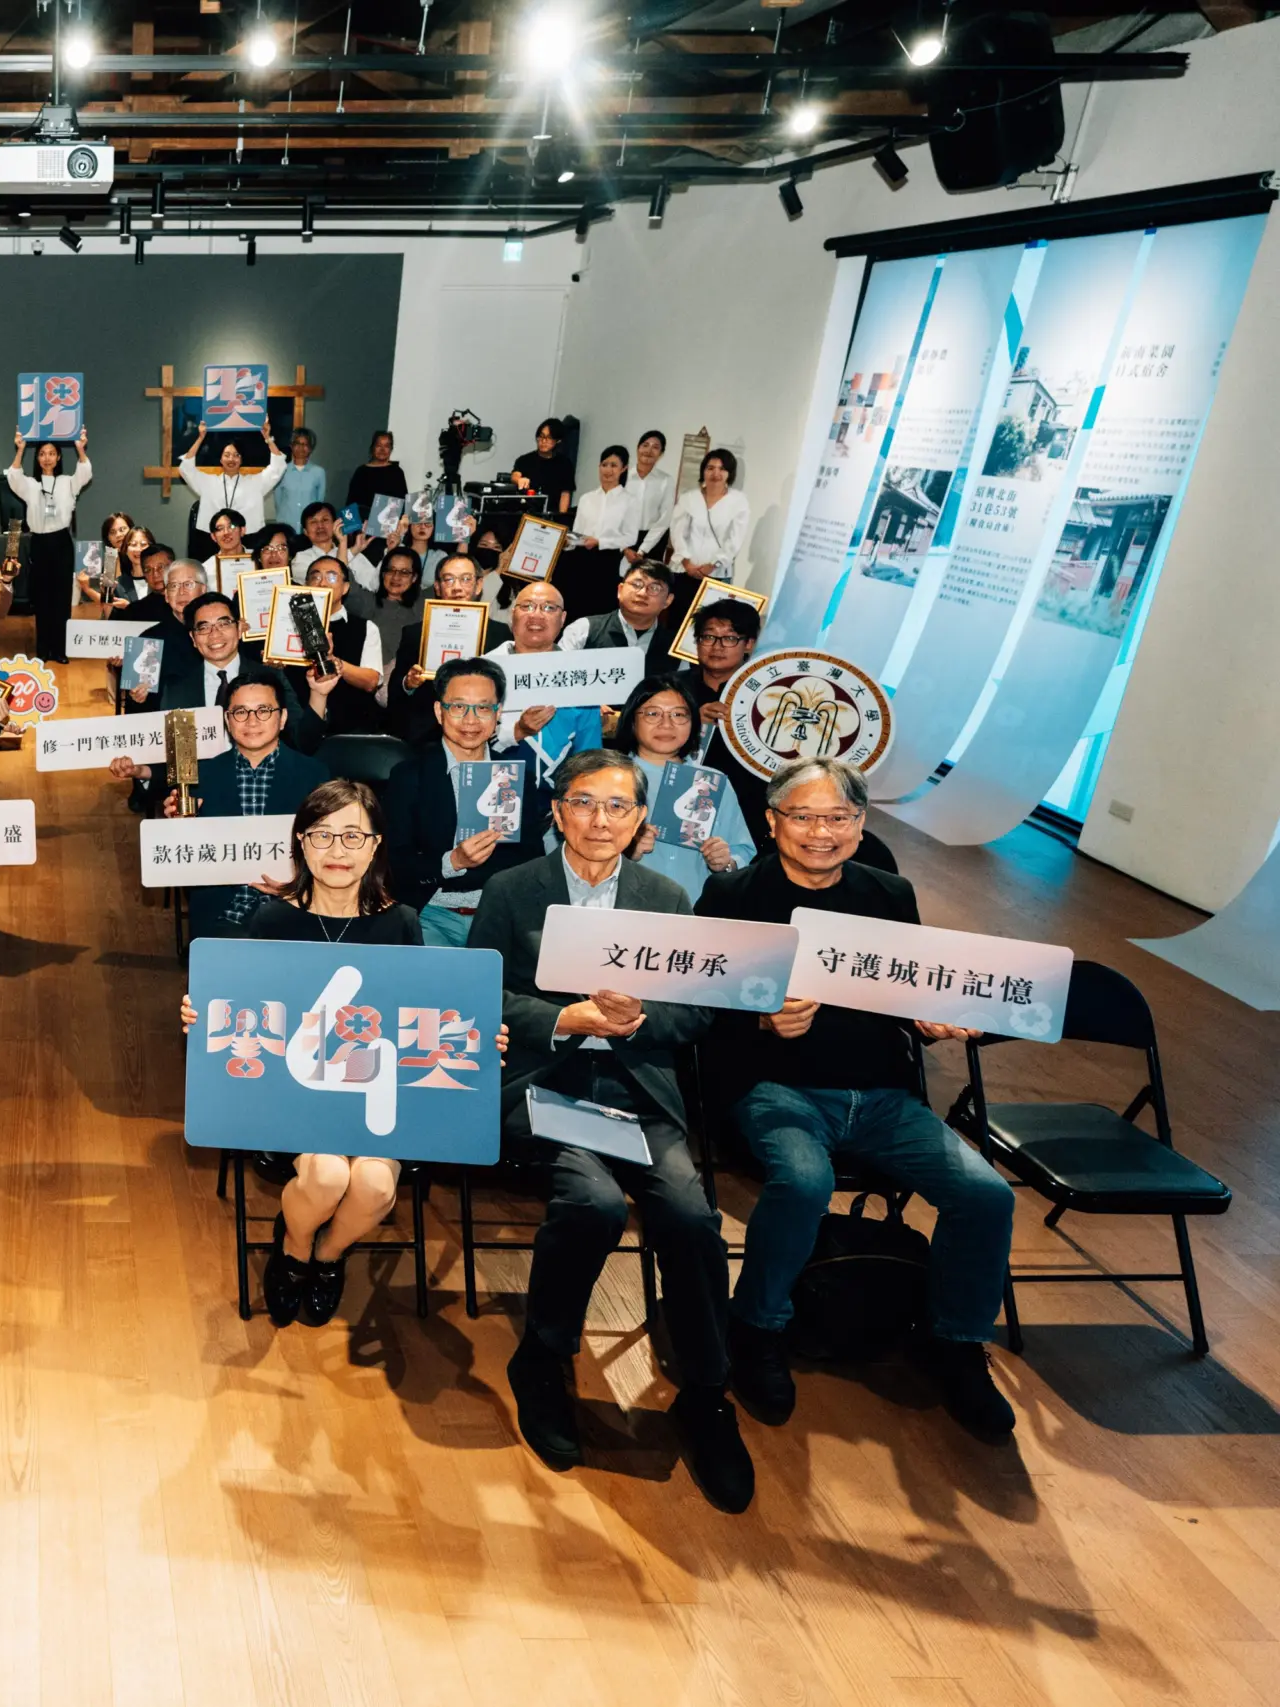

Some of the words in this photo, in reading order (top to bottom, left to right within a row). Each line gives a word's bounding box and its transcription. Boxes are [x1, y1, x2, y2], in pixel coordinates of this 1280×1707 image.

[514, 667, 626, 690] 國立臺灣大學
[42, 726, 217, 755] 修一門筆墨時光課
[735, 713, 762, 757] National
[152, 841, 295, 864] 款待歲月的不
[600, 943, 729, 978] 文化傳承
[816, 946, 1035, 1006] 守護城市記憶
